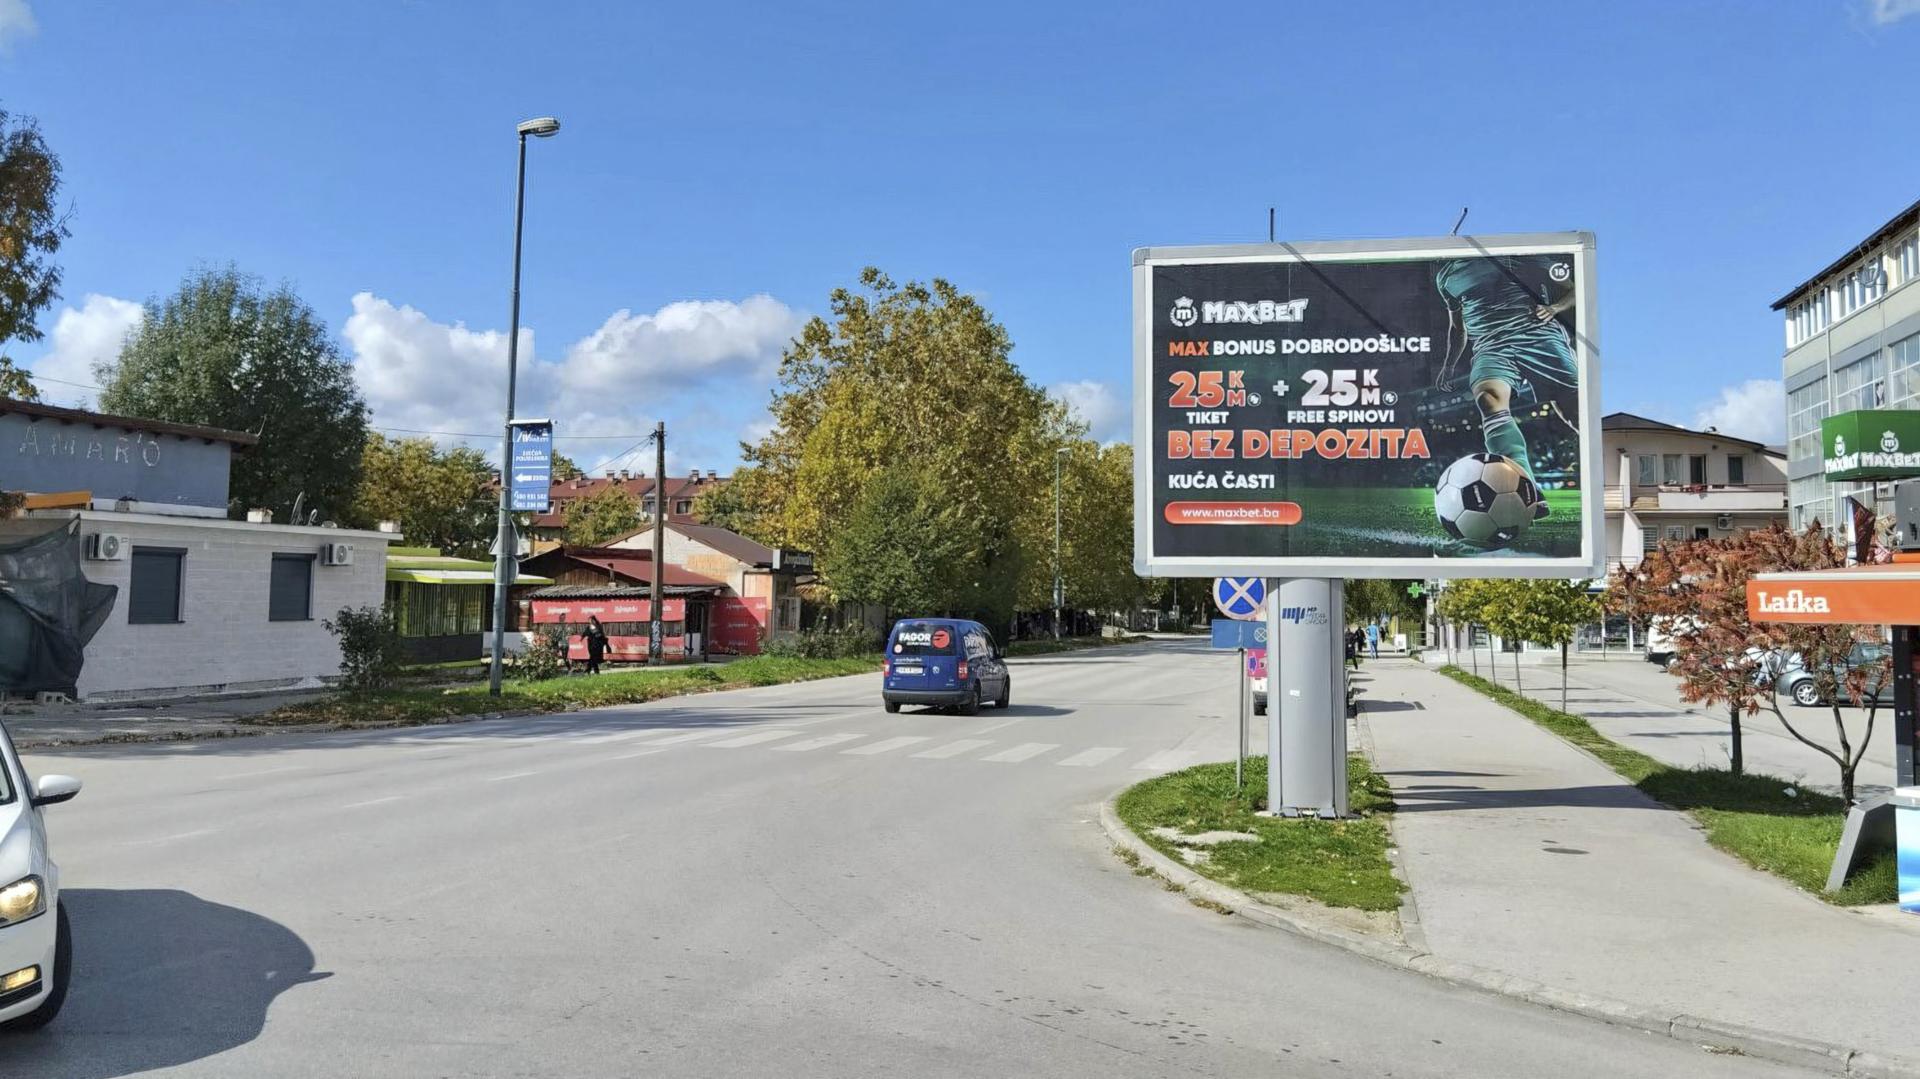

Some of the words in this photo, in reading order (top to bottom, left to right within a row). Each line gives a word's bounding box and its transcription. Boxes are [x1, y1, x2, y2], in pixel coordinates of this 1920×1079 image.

[1168, 341, 1209, 356] MAX
[1213, 339, 1276, 355] BONUS
[1281, 334, 1431, 354] DOBRODOŠLICE
[1168, 370, 1225, 408] 25
[1301, 369, 1359, 407] 25
[1186, 411, 1230, 424] TIKET
[1287, 410, 1325, 423] FREE
[1328, 409, 1395, 423] SPINOVI
[1167, 429, 1235, 459] BEZ
[1242, 428, 1431, 459] DEPOZITA
[1168, 471, 1218, 489] KUĆA
[1222, 470, 1275, 489] ČASTI
[1182, 507, 1280, 519] www.maxbet.ba
[1756, 589, 1830, 613] Lafka
[898, 632, 932, 642] FAGOR
